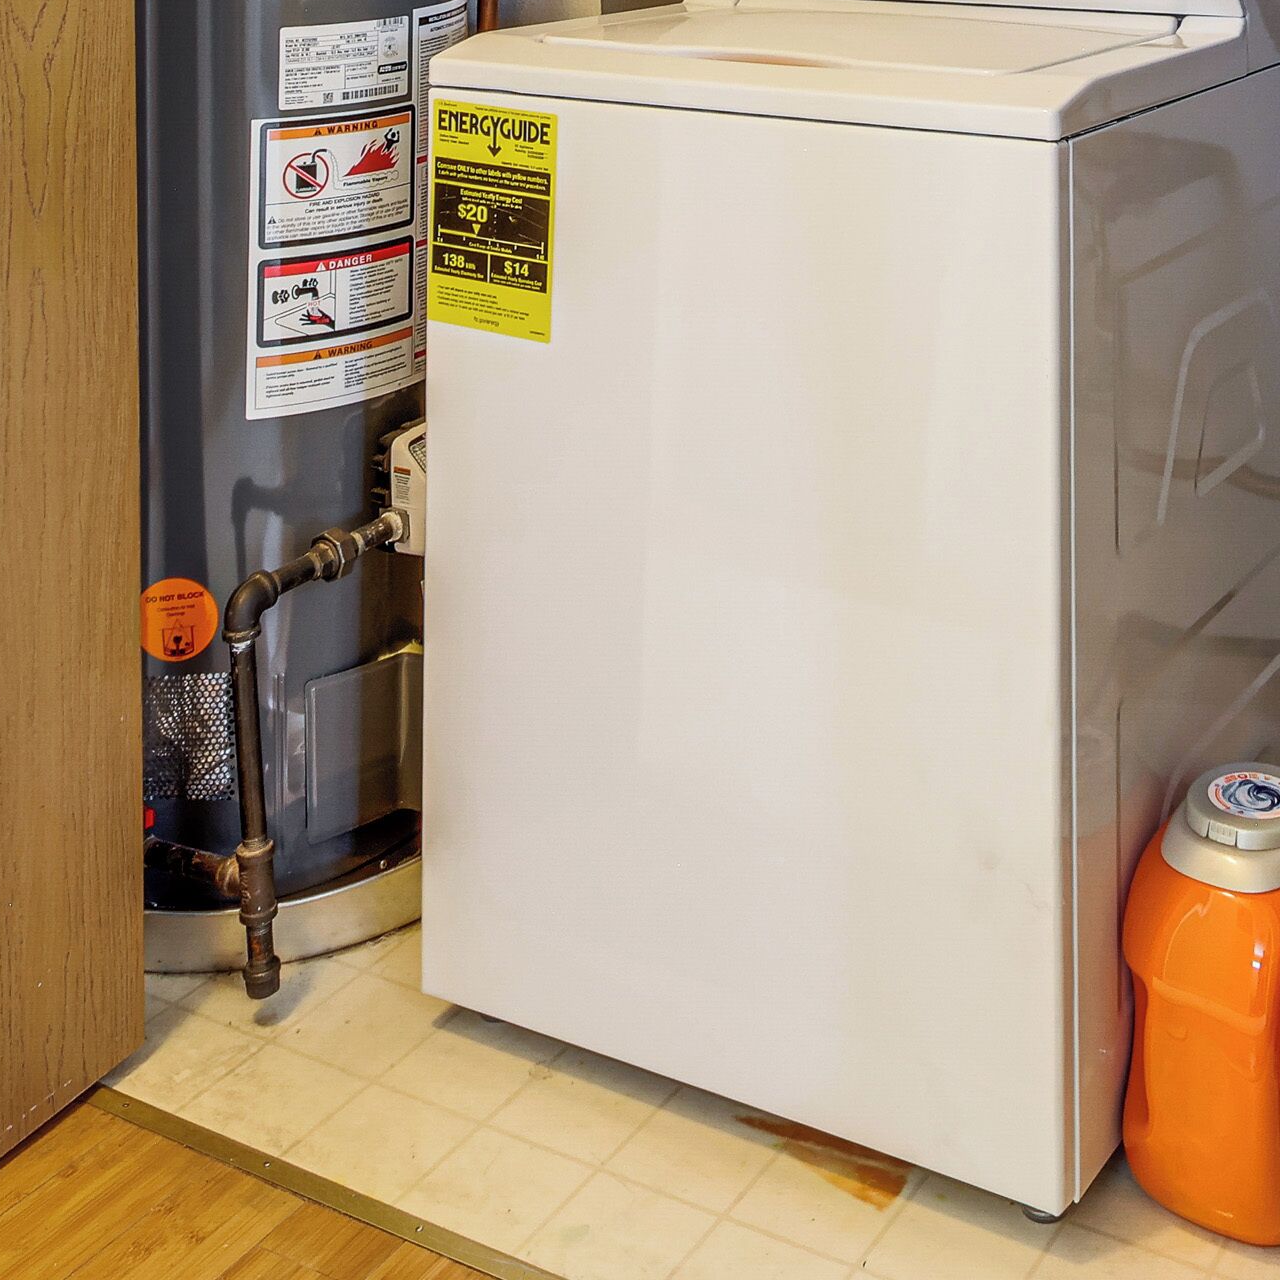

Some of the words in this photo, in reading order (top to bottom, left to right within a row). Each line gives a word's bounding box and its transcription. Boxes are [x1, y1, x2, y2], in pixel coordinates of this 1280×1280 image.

[326, 120, 380, 136] WARNING
[437, 109, 551, 145] ENERGYGUIDE
[437, 161, 457, 171] Compare
[457, 164, 470, 172] ONLY
[475, 167, 488, 175] other
[487, 168, 502, 178] labels
[501, 170, 512, 178] with
[512, 173, 527, 181] yellow
[512, 196, 523, 205] Cost
[457, 203, 488, 223] $20
[328, 253, 373, 270] DANGER
[442, 252, 465, 269] 138
[503, 260, 529, 277] $14
[327, 341, 373, 358] WARNING
[159, 594, 175, 602] NOT
[176, 590, 205, 600] BLOCK
